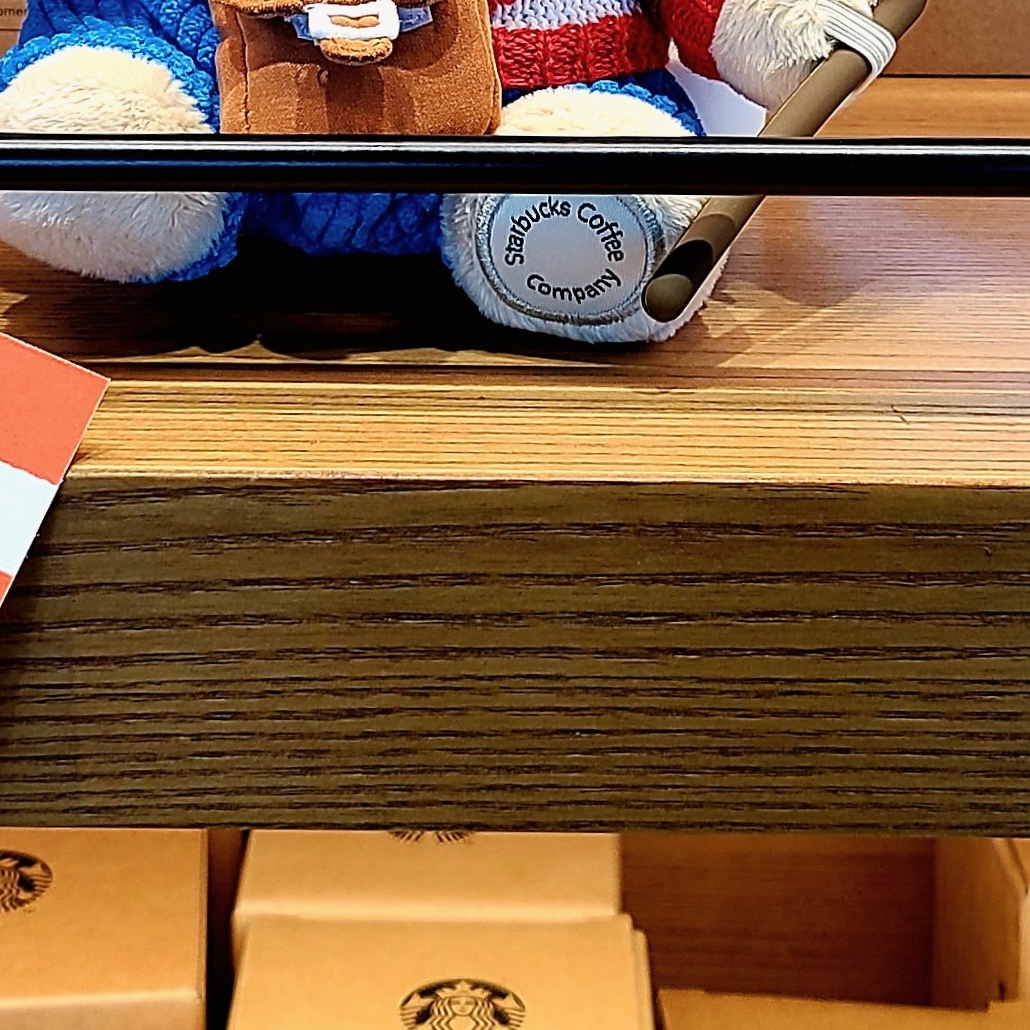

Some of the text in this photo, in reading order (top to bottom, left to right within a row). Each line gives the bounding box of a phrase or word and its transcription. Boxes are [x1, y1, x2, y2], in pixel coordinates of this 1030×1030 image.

[504, 195, 625, 266] Starbucks Coffee
[526, 268, 622, 305] Company
